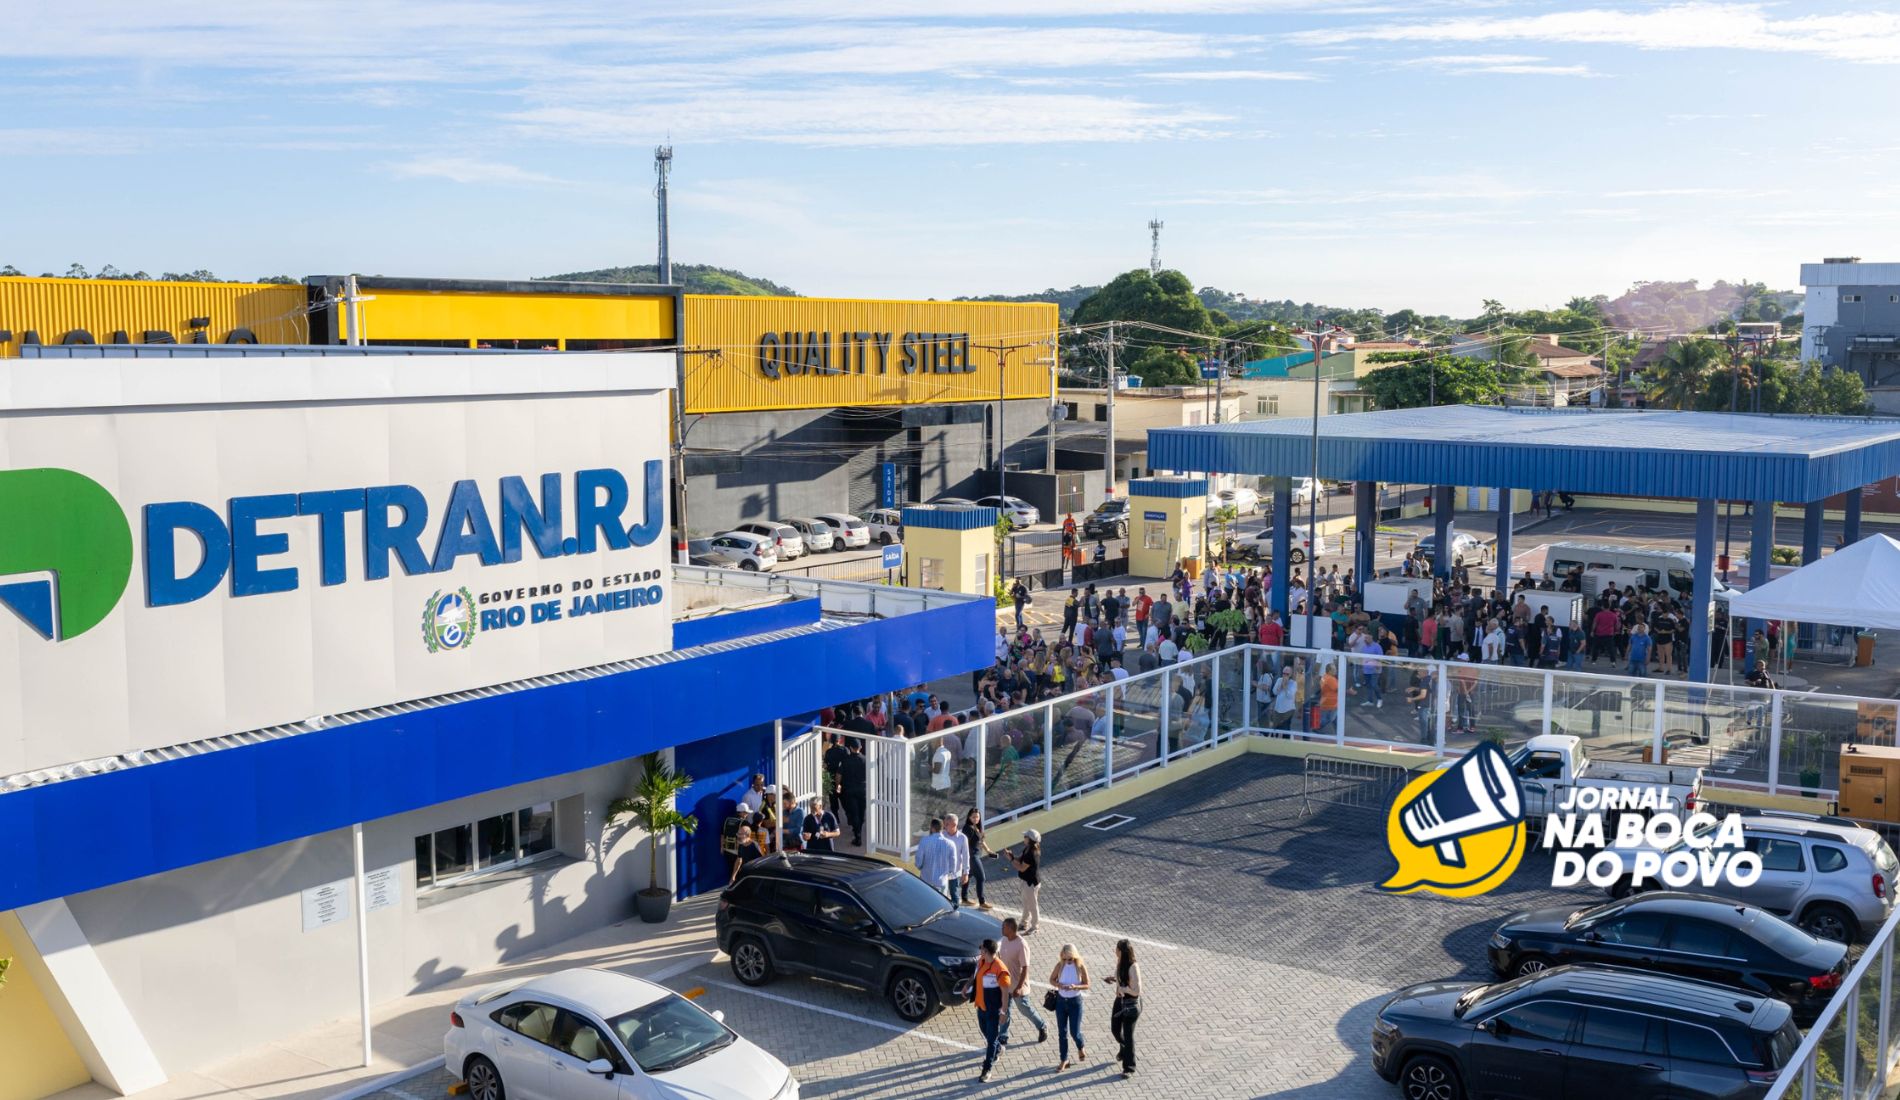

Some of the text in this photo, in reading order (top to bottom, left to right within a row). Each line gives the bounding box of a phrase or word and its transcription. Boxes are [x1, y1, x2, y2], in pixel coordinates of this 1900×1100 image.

[760, 331, 976, 380] QUALITY STEEL
[144, 459, 664, 609] DETRAN.RJ
[479, 569, 662, 605] GOVERNO DO ESTADO
[480, 584, 664, 632] RIO DE JANEIRO
